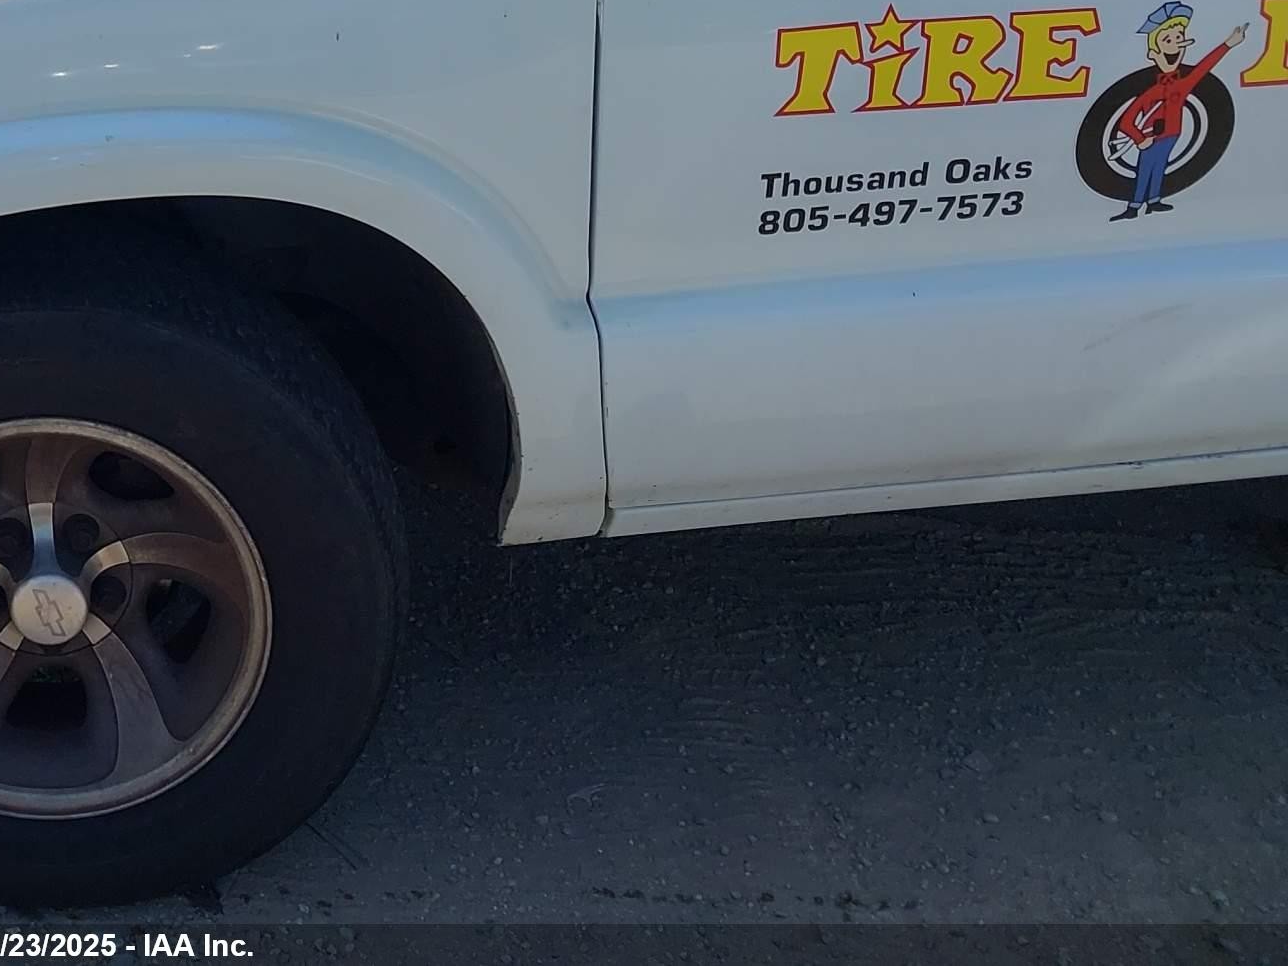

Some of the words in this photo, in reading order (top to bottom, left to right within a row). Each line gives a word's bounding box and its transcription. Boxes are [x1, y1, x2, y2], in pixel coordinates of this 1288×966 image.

[759, 161, 929, 199] Thousand
[945, 156, 1033, 185] Oaks
[758, 190, 1024, 236] 805-497-7573
